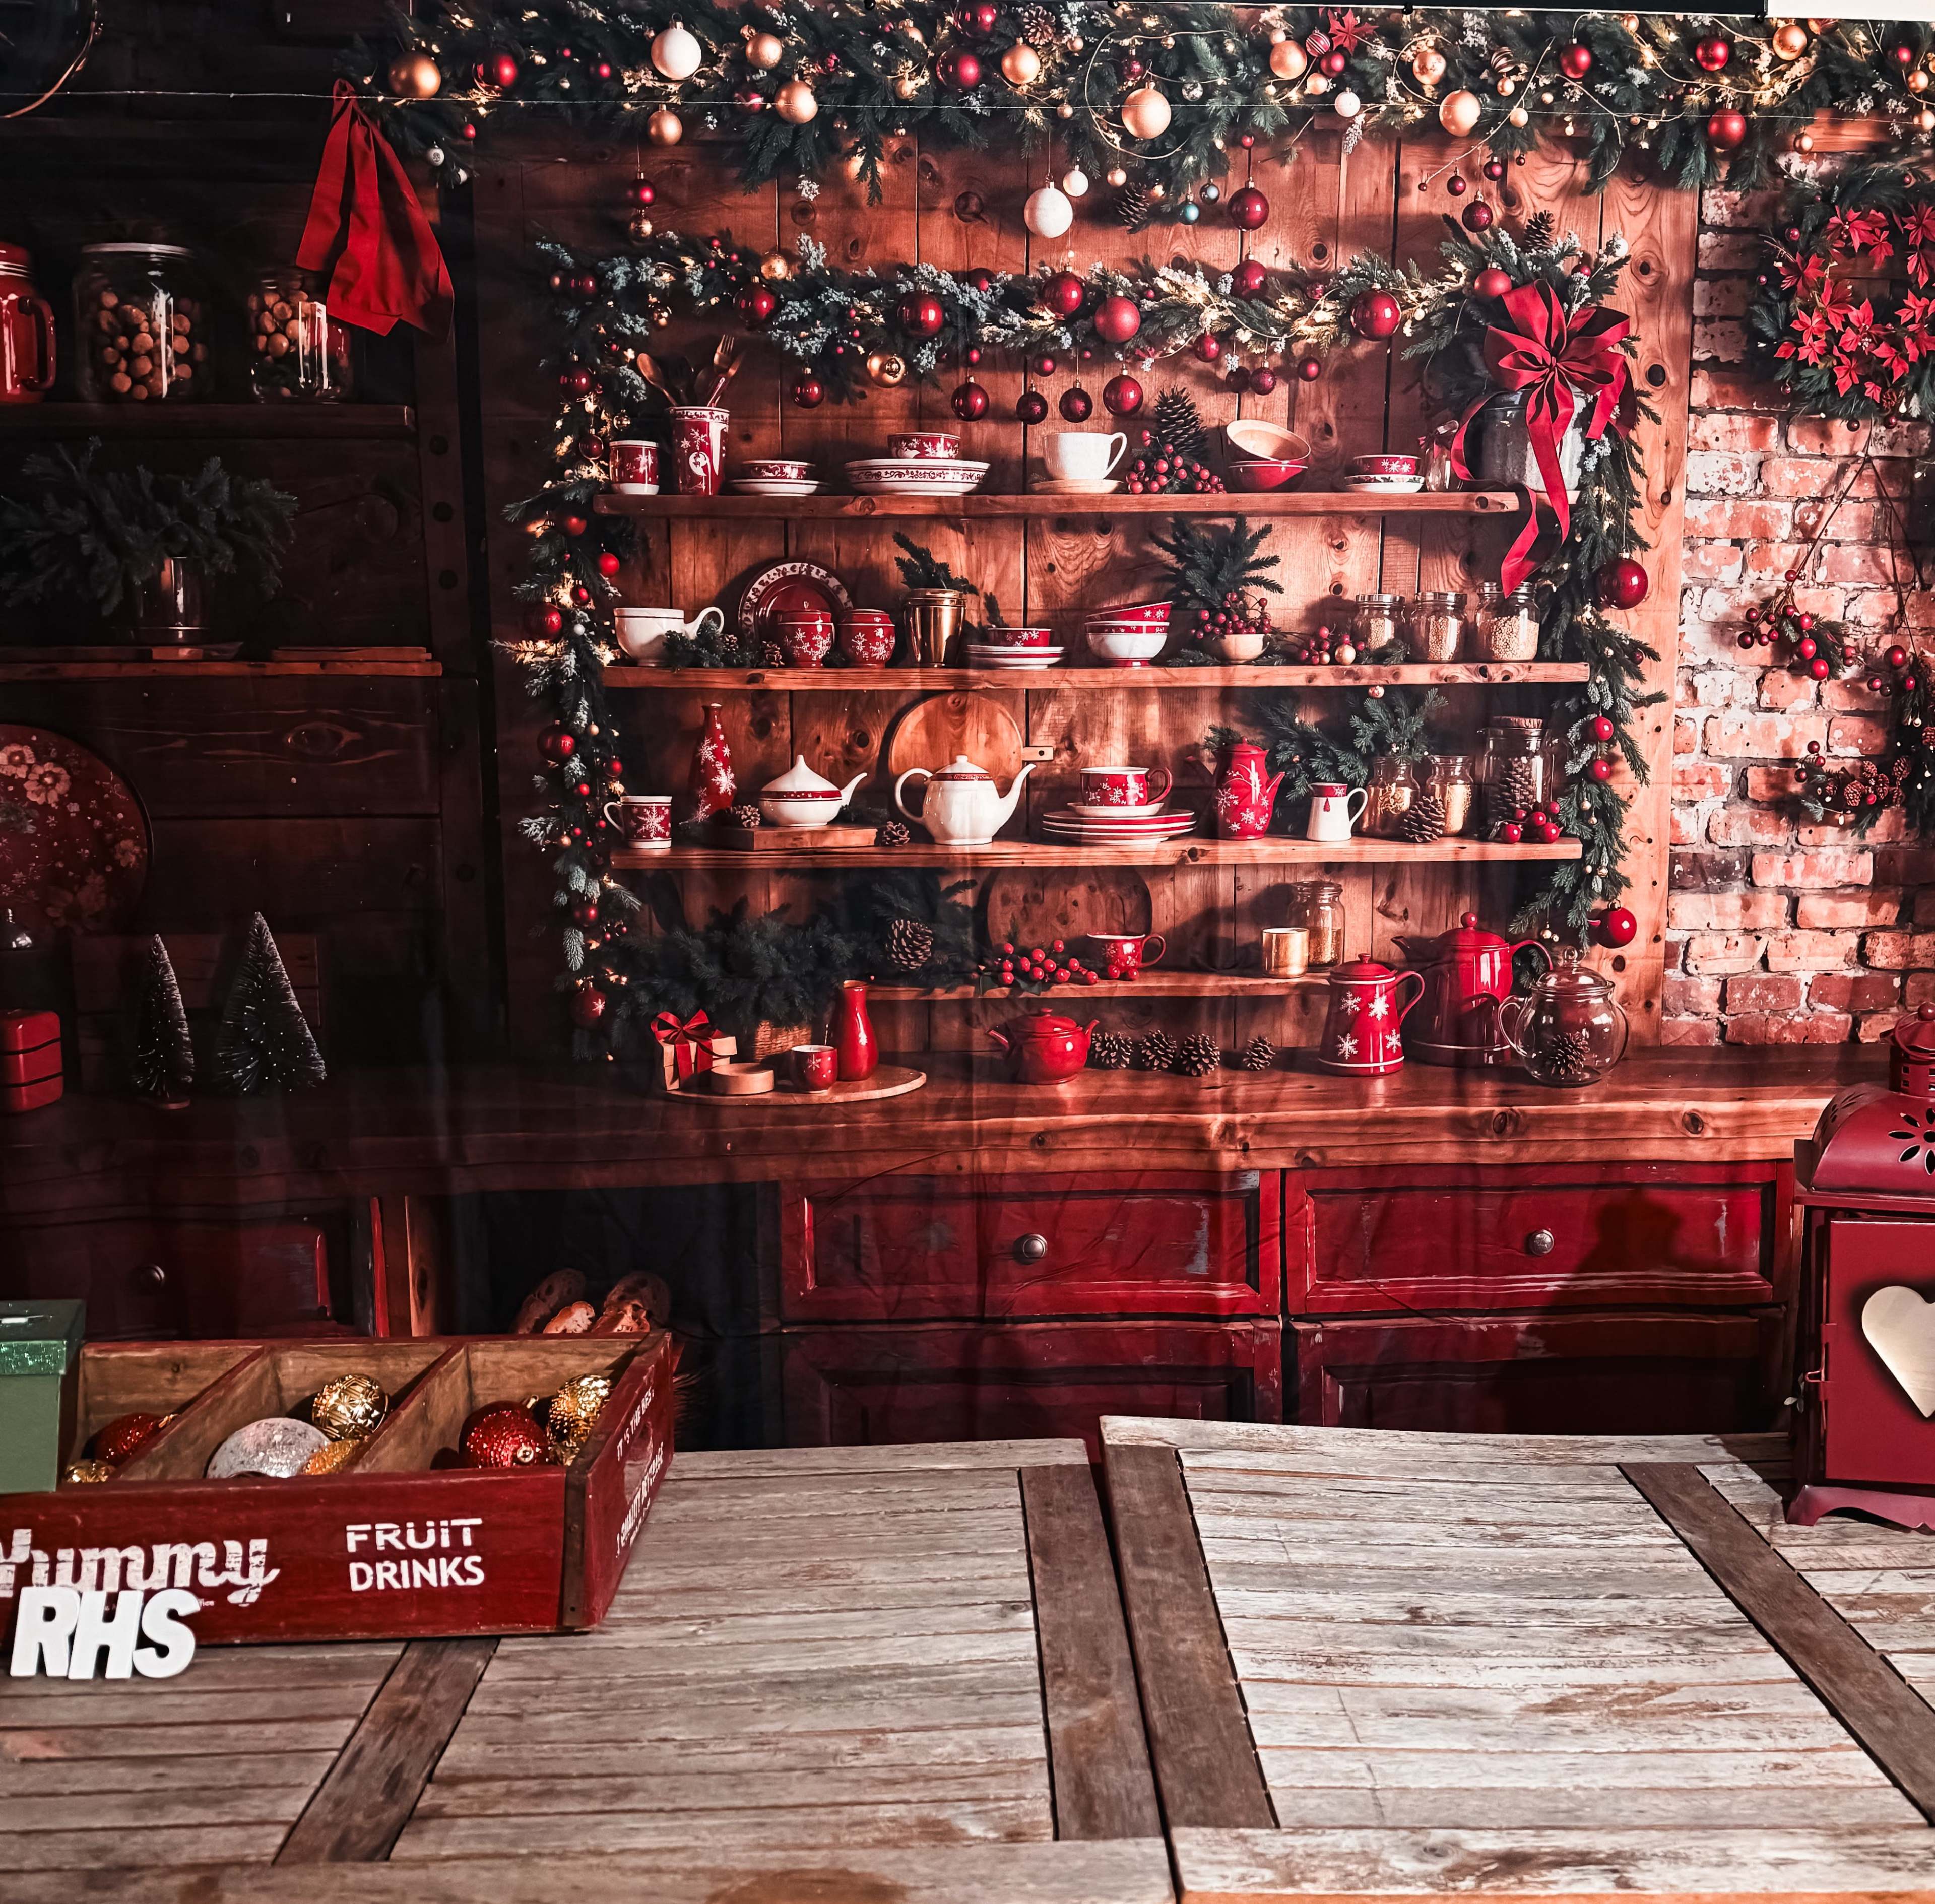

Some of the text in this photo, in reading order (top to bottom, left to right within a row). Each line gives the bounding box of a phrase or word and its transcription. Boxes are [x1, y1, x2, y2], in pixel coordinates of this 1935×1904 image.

[630, 1405, 641, 1435] THE
[346, 1518, 482, 1553] FRUIT
[349, 1555, 485, 1591] DRINKS
[10, 1586, 201, 1680] RHS
